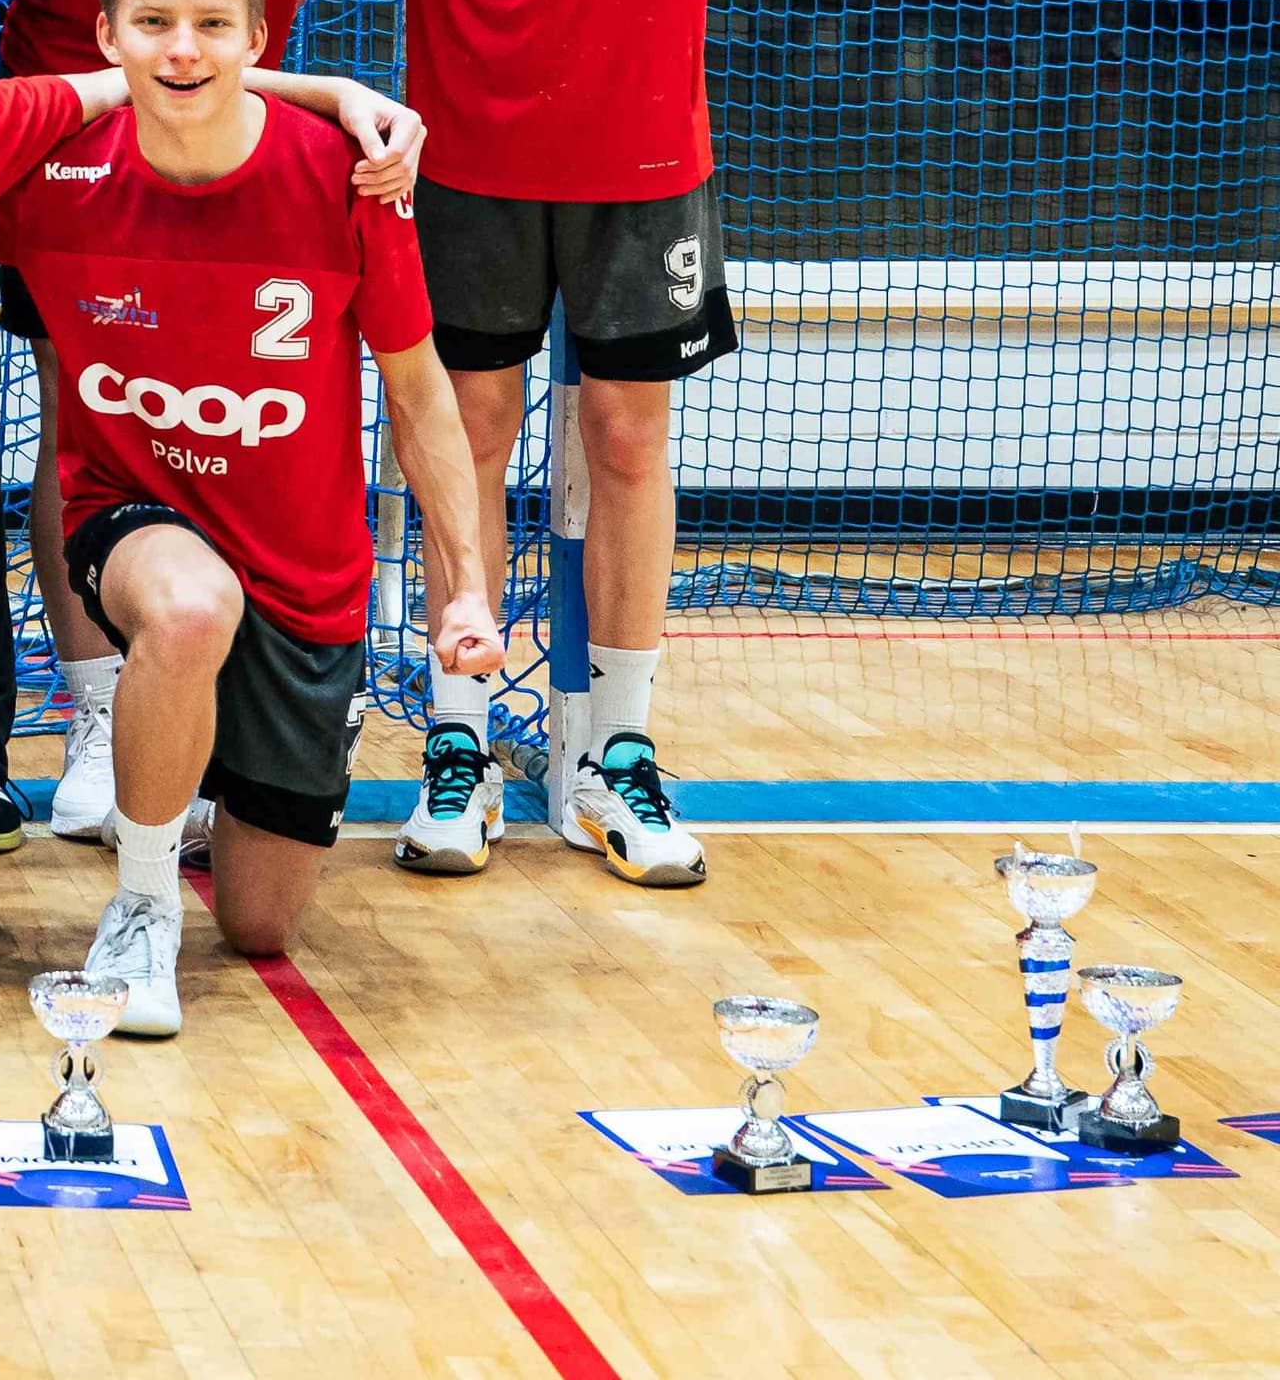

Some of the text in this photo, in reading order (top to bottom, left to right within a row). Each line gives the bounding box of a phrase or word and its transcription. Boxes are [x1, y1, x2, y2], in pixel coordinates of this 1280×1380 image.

[44, 160, 111, 184] Kempa
[663, 234, 704, 311] 9
[251, 277, 313, 361] 2
[78, 362, 306, 447] coop
[151, 439, 229, 476] Põlva
